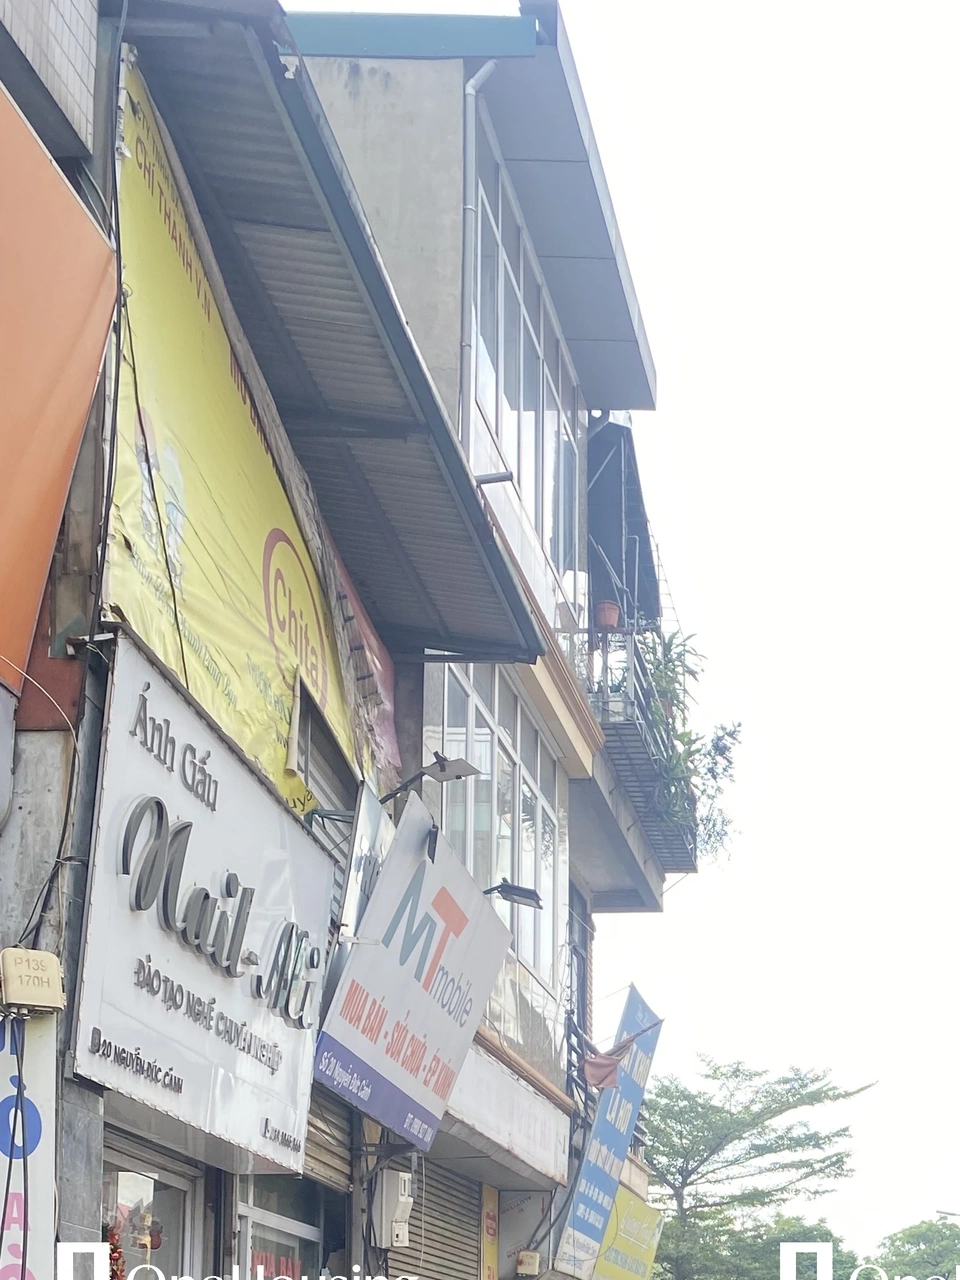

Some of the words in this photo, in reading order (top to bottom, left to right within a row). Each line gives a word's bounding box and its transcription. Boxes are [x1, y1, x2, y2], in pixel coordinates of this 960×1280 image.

[273, 567, 322, 694] Chita
[129, 680, 177, 773] Ánh
[181, 750, 219, 812] Gấu
[17, 974, 50, 989] 170H
[161, 974, 184, 1012] TẠO
[428, 964, 473, 1028] mobile
[101, 1038, 112, 1059] 20
[339, 978, 370, 1030] MUA
[360, 995, 389, 1045] BÁN
[422, 1047, 441, 1088] ÉP
